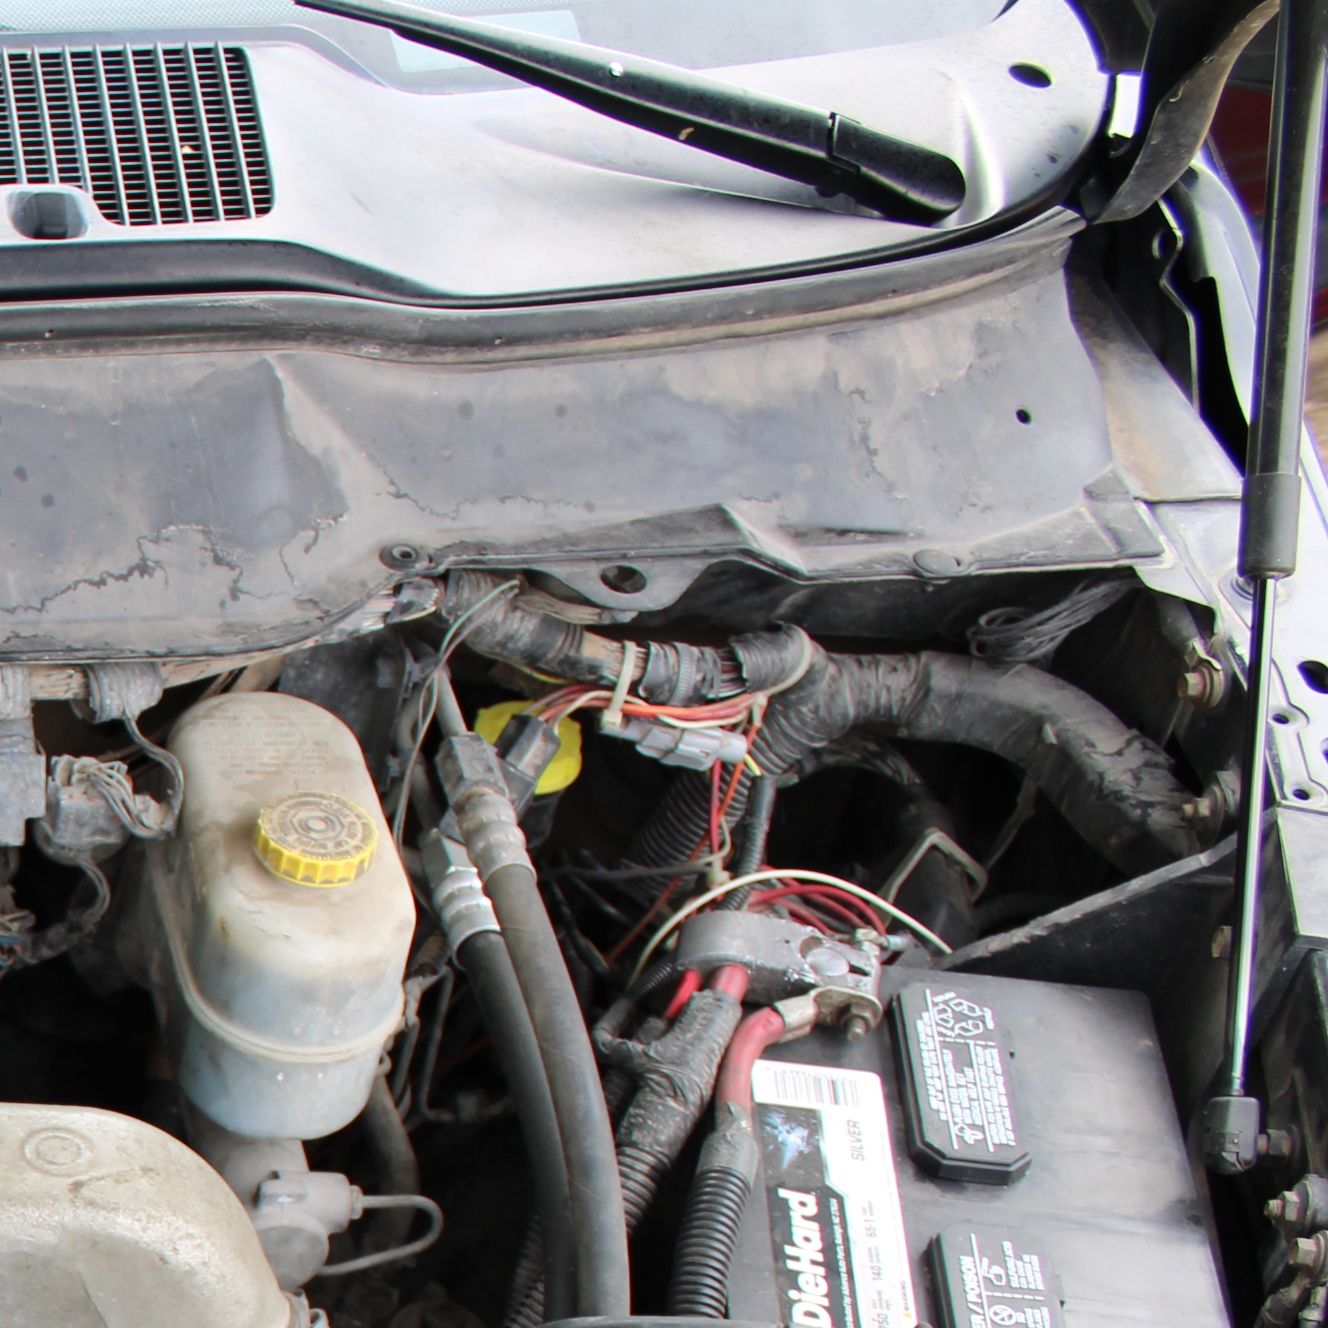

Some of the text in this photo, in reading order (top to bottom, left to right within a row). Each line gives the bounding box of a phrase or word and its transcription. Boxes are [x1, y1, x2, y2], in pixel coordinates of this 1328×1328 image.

[847, 1119, 865, 1162] SILVER
[869, 1264, 883, 1280] 140
[959, 1255, 982, 1303] POISON
